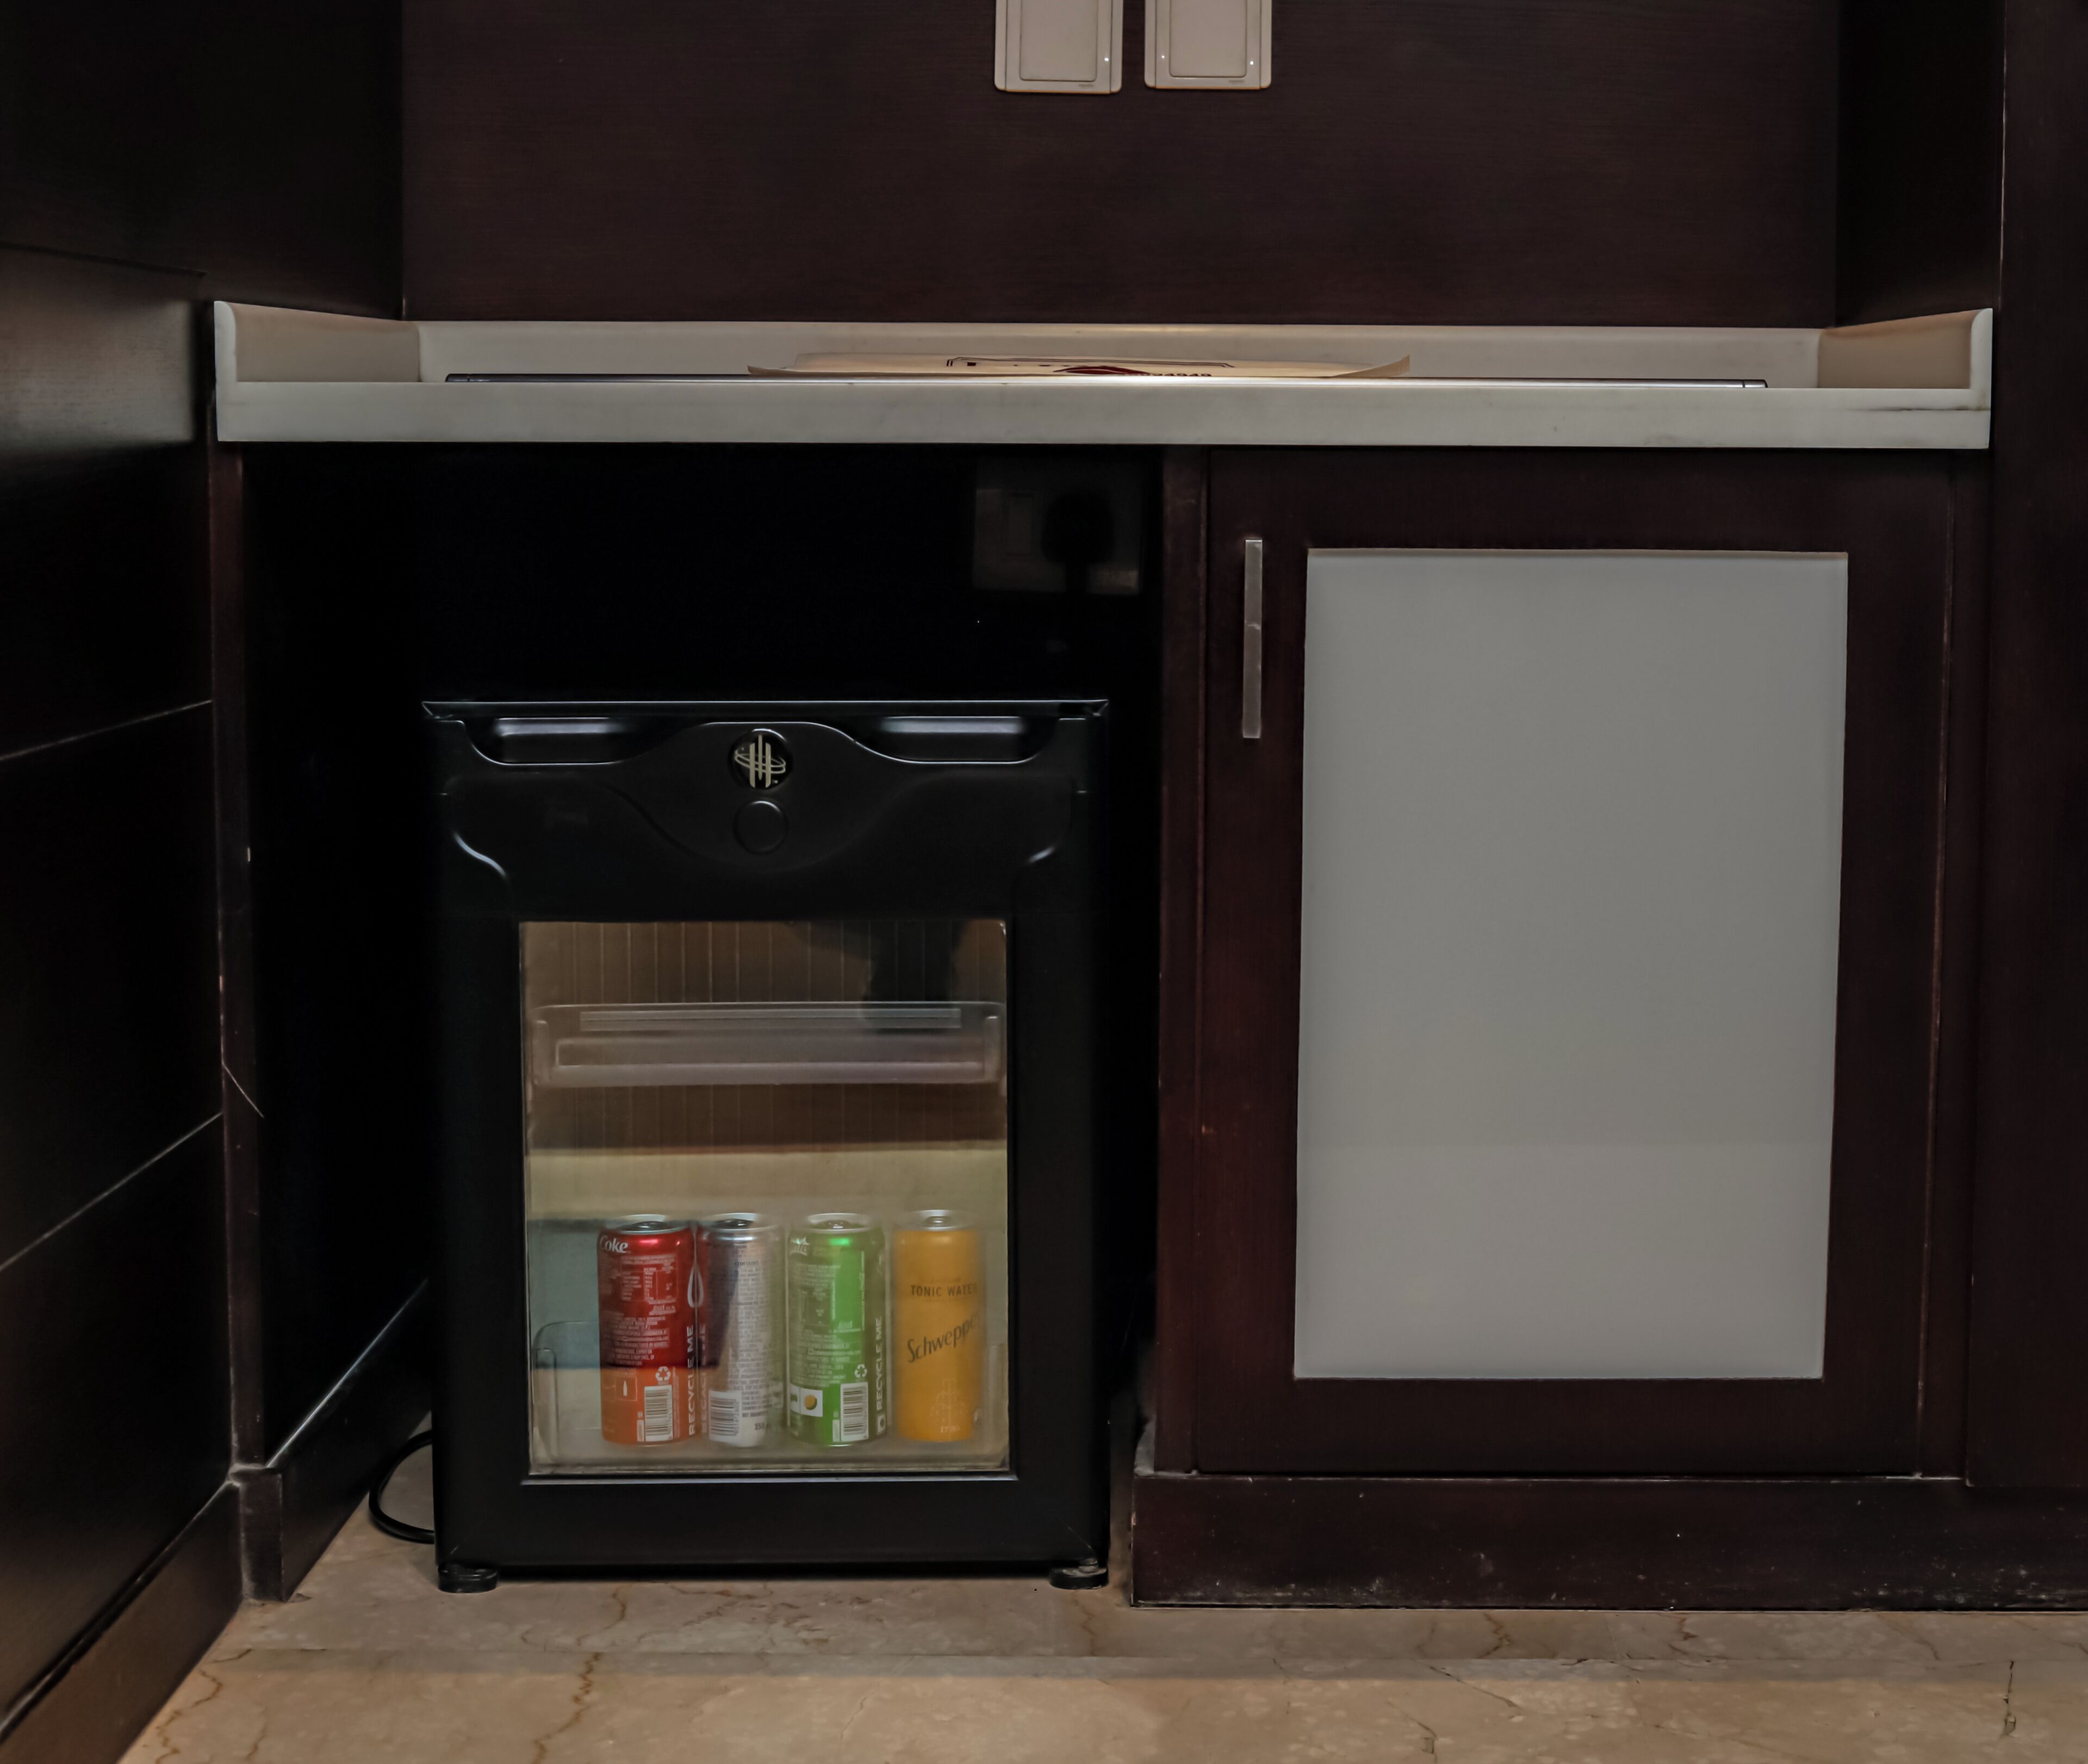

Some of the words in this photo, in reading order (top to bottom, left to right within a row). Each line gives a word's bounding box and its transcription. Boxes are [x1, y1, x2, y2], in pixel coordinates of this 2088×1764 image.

[599, 1235, 629, 1253] Coke
[910, 1284, 942, 1297] TONIC
[687, 1325, 694, 1353] ME
[875, 1316, 882, 1340] ME
[687, 1358, 695, 1436] RECYCLE
